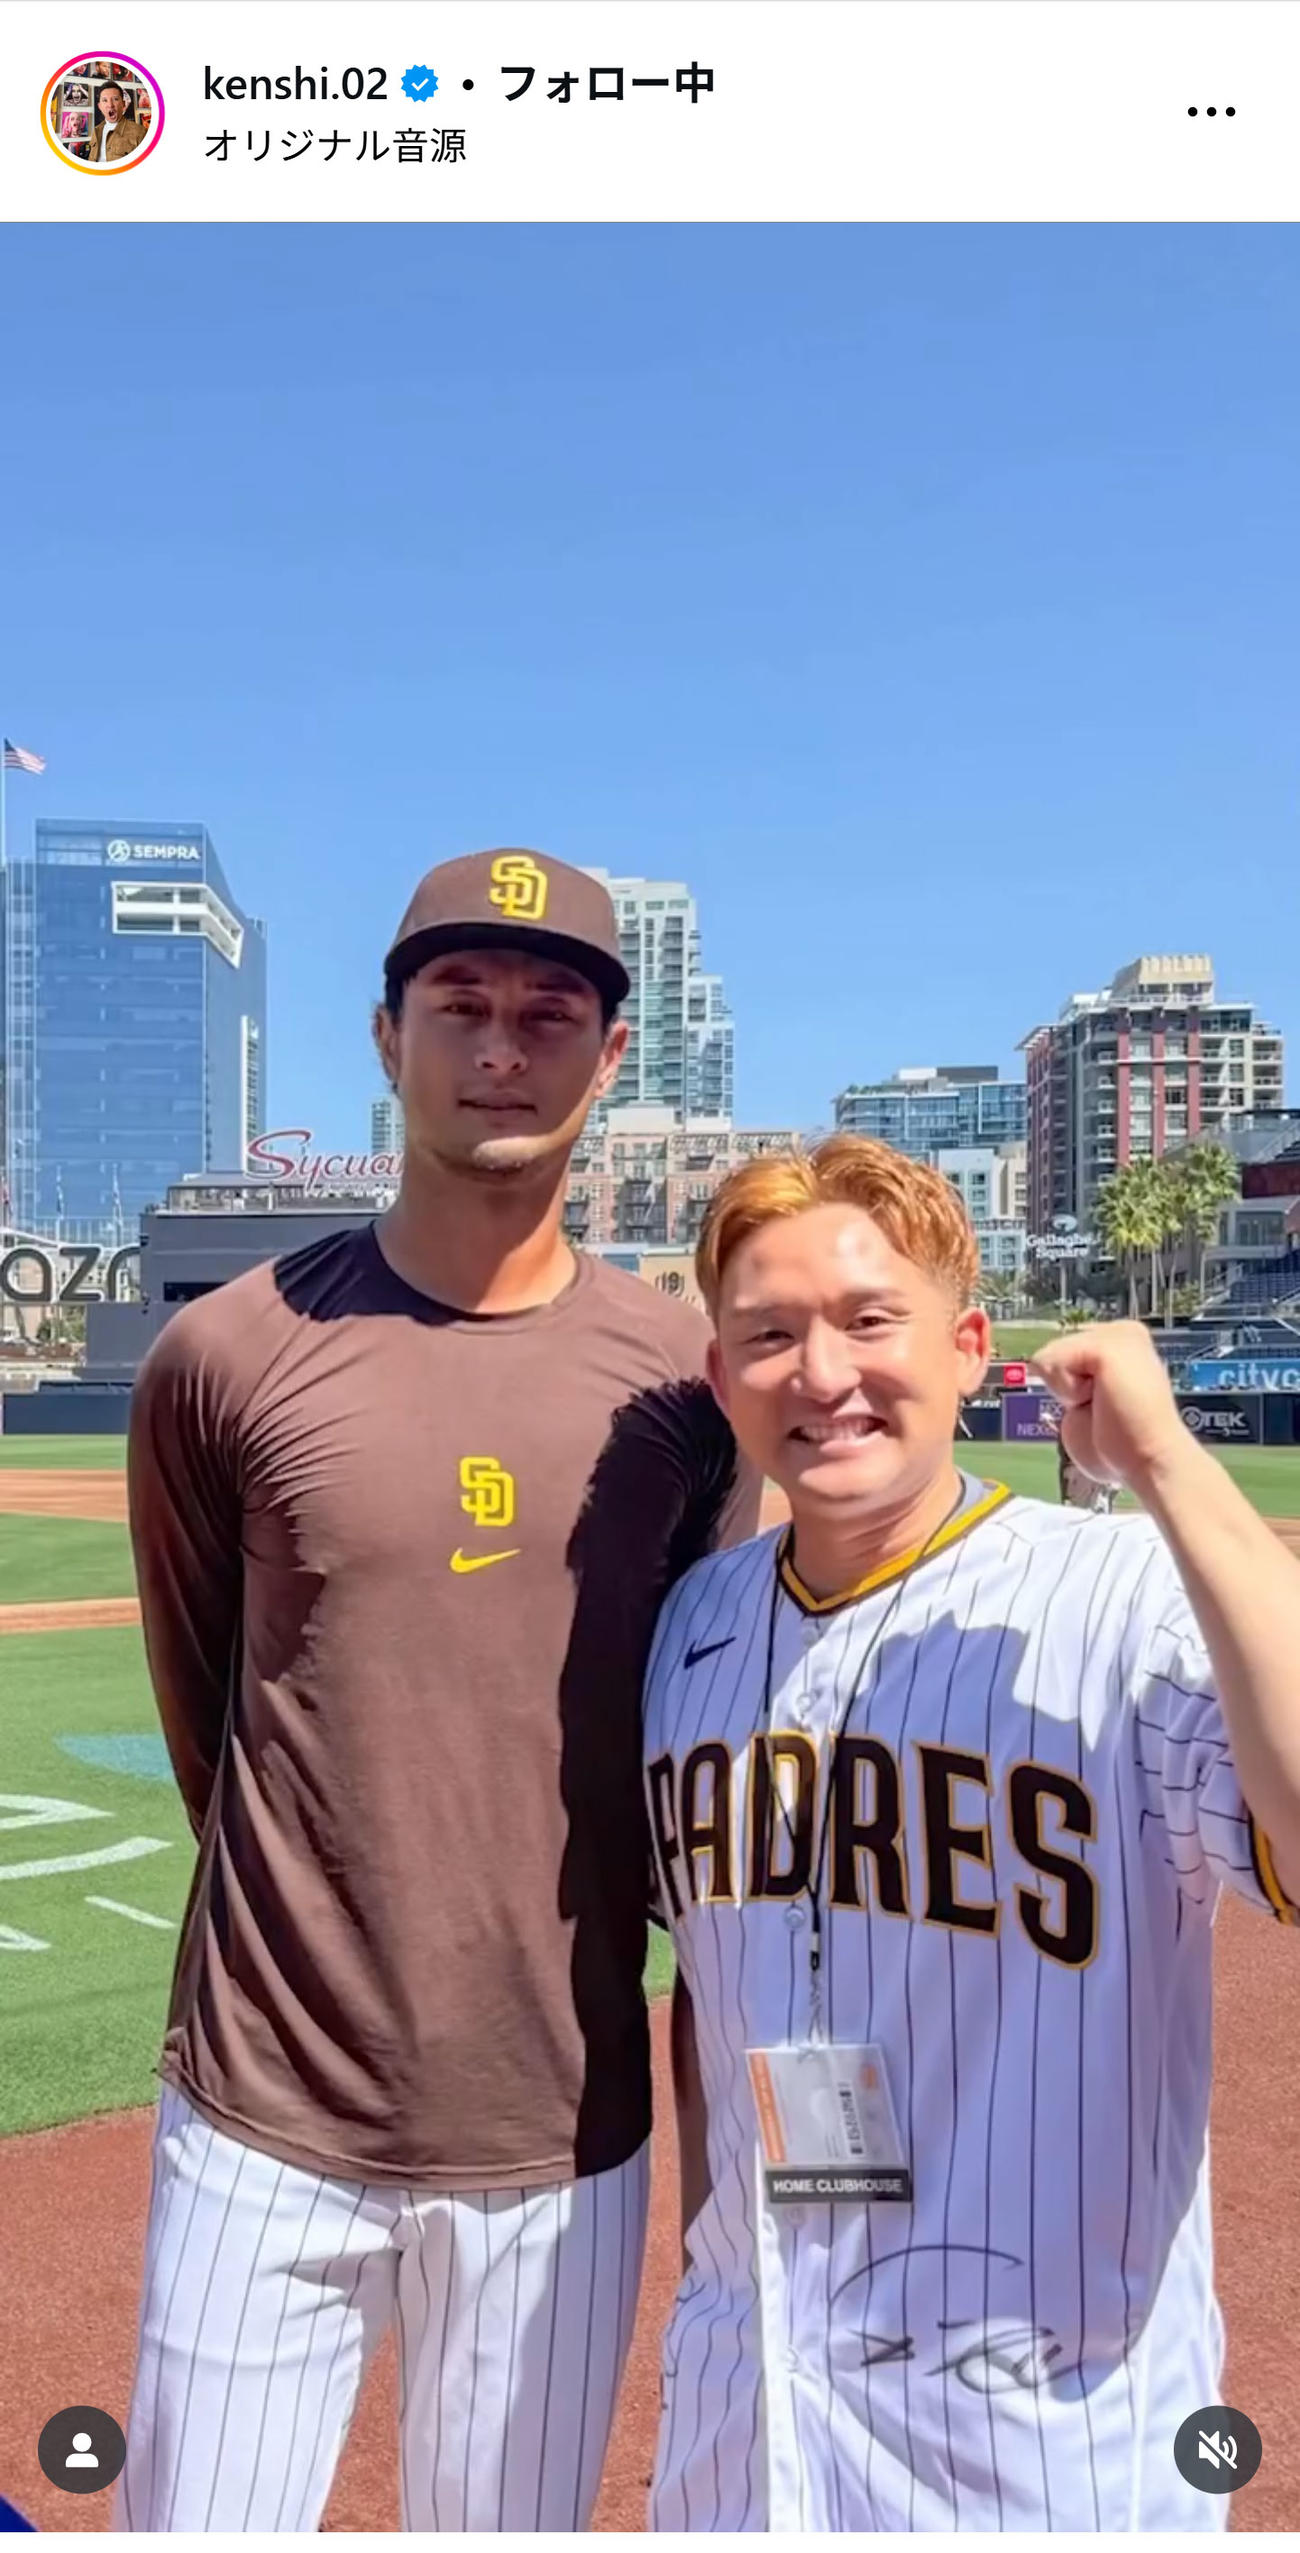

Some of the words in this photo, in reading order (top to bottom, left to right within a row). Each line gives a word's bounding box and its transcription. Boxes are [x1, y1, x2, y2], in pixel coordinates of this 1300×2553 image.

[133, 844, 201, 860] SEMPRA
[489, 855, 548, 920] SD
[460, 1456, 514, 1527] SD
[648, 1729, 1097, 1970] PADRES
[773, 2180, 815, 2192] HOME
[816, 2179, 903, 2193] CLUBHOUSE
